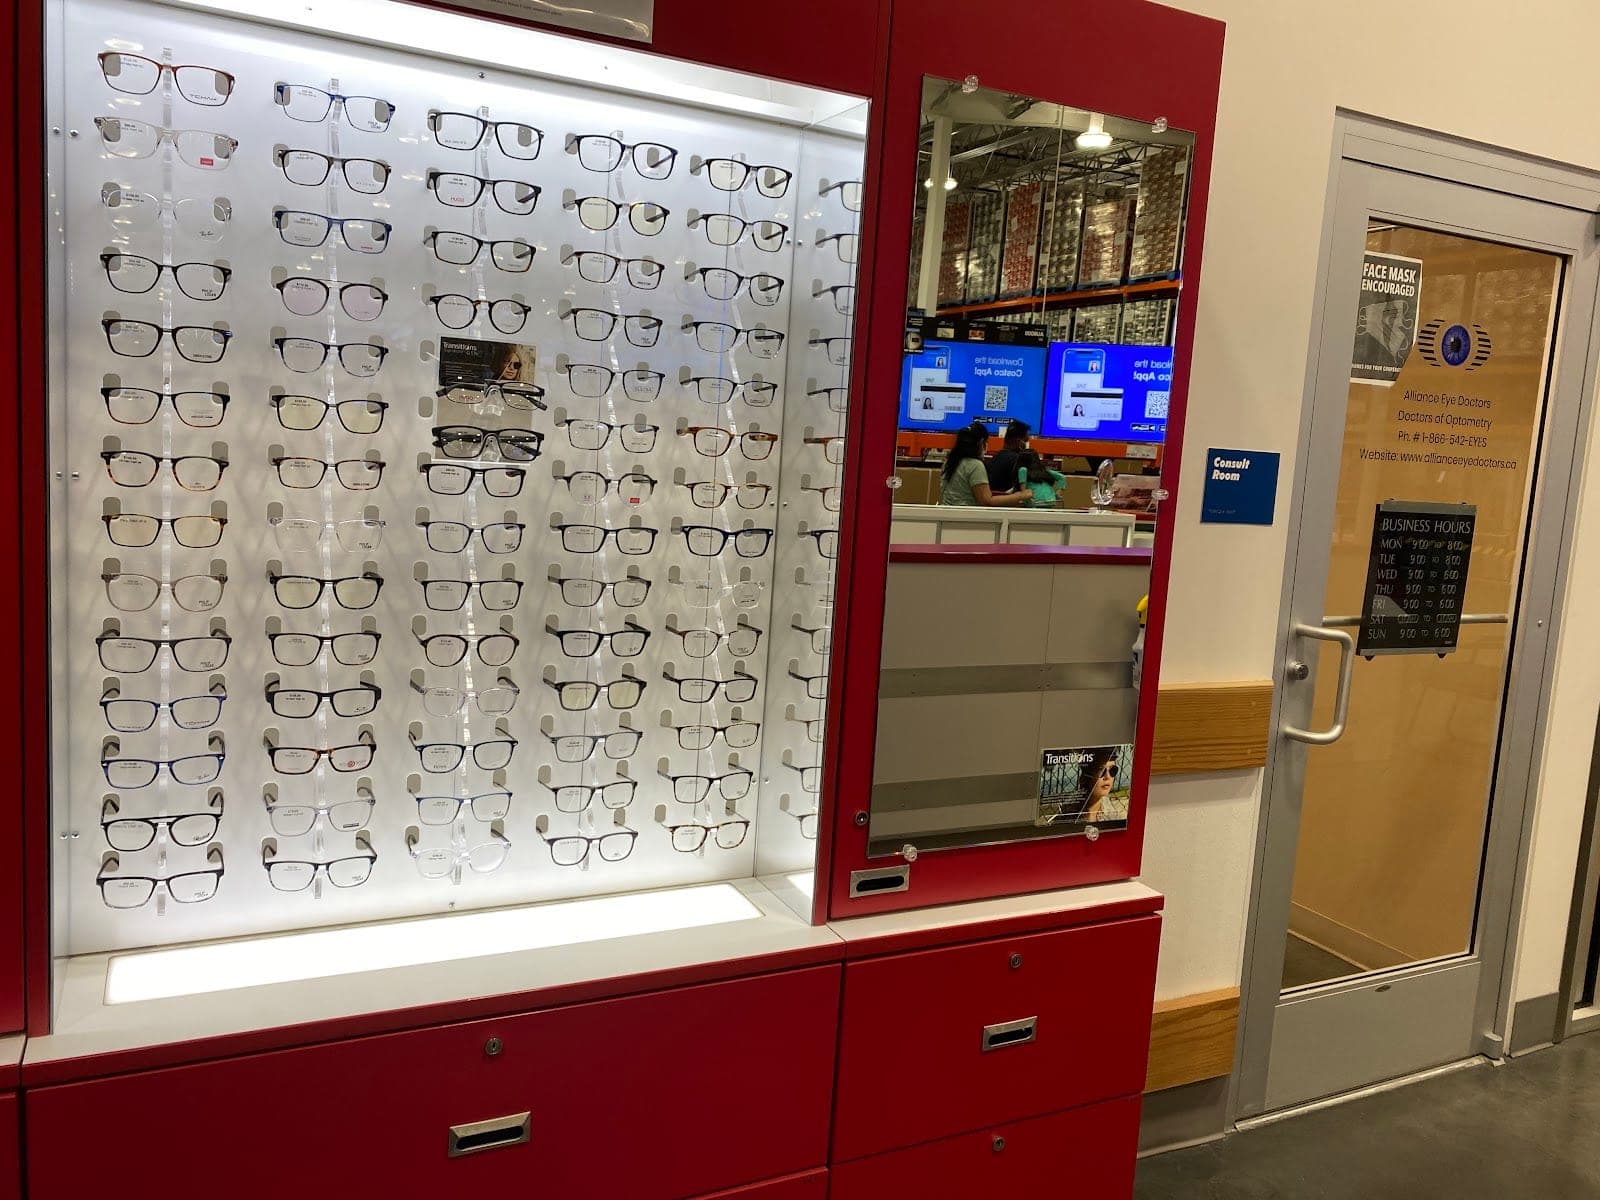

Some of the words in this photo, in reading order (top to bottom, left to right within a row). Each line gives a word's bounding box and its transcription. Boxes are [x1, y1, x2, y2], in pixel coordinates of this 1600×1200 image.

[1363, 263, 1387, 278] FACE
[1389, 267, 1416, 283] MASK
[1362, 279, 1414, 296] ENCOURAGED
[1404, 390, 1439, 404] Alliance
[1441, 394, 1456, 407] Eye
[1458, 396, 1491, 408] Doctors
[1398, 410, 1432, 424] Doctors
[1435, 413, 1444, 424] of
[1446, 415, 1492, 431] Optometry
[1413, 432, 1420, 442] #
[1214, 457, 1250, 469] Consult
[1360, 448, 1399, 461] Website:
[1400, 453, 1516, 470] www.allianceeyedoctors.ca
[1212, 469, 1240, 480] Room
[1382, 518, 1430, 532] BUSINESS
[1434, 521, 1471, 534] HOURS
[1381, 539, 1402, 549] MON
[1380, 554, 1396, 564] TUE
[1377, 569, 1398, 579] WED
[1375, 584, 1394, 594] THU
[1372, 599, 1386, 609] FRI
[1370, 614, 1386, 624] SAT
[1368, 628, 1387, 639] SUN
[1046, 750, 1094, 764] Transitions
